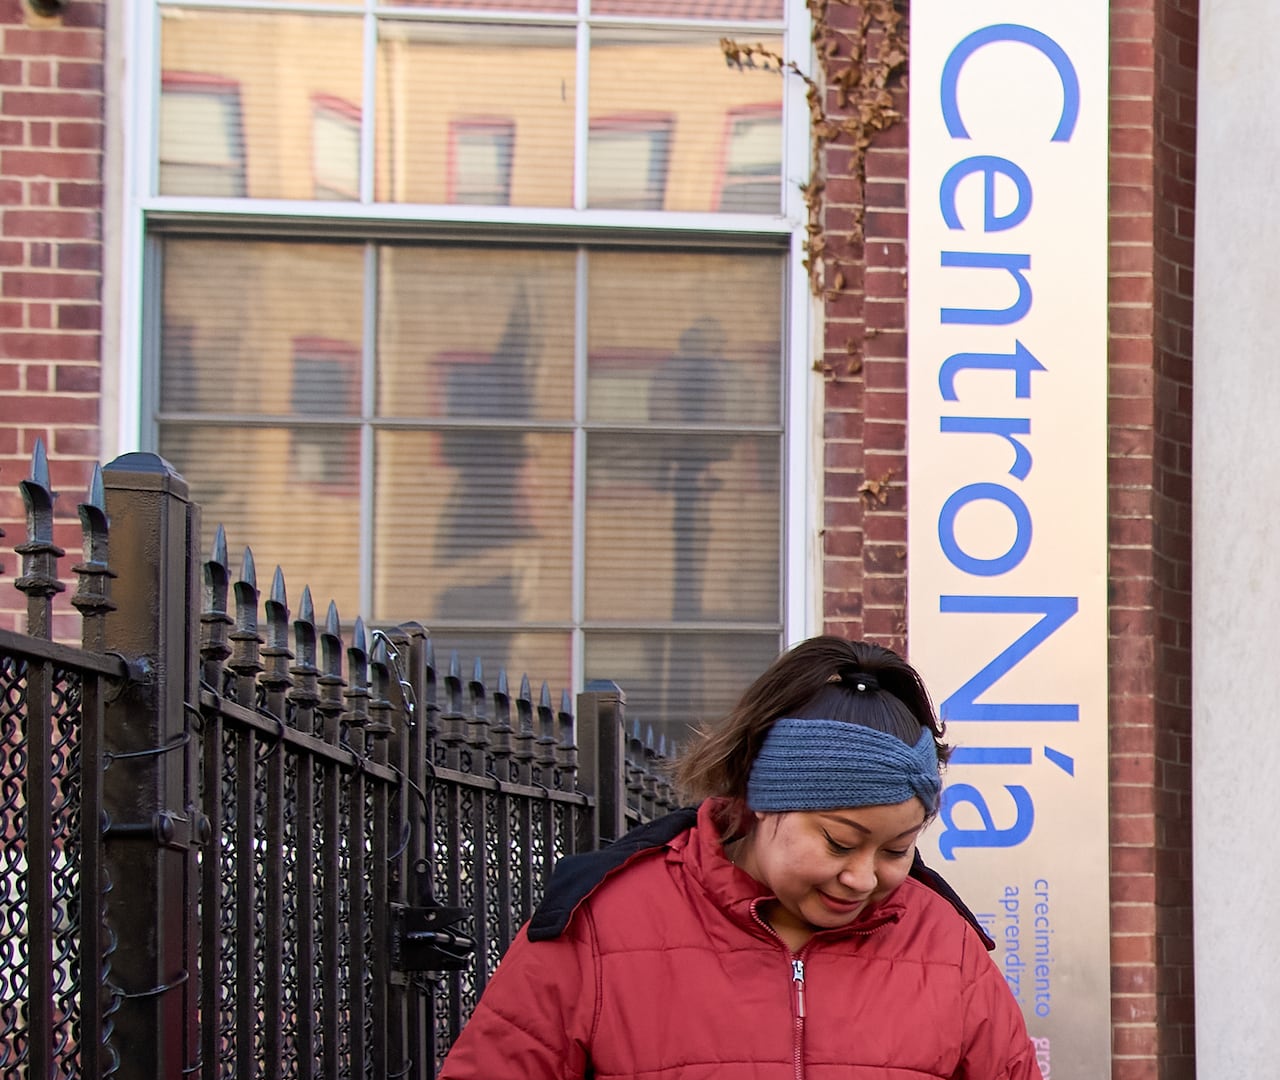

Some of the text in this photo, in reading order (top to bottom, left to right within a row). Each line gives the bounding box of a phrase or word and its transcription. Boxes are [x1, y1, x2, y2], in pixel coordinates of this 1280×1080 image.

[938, 23, 1081, 861] CentroNía
[998, 886, 1026, 1003] aprendiz
[1034, 879, 1055, 1018] crecimiento
